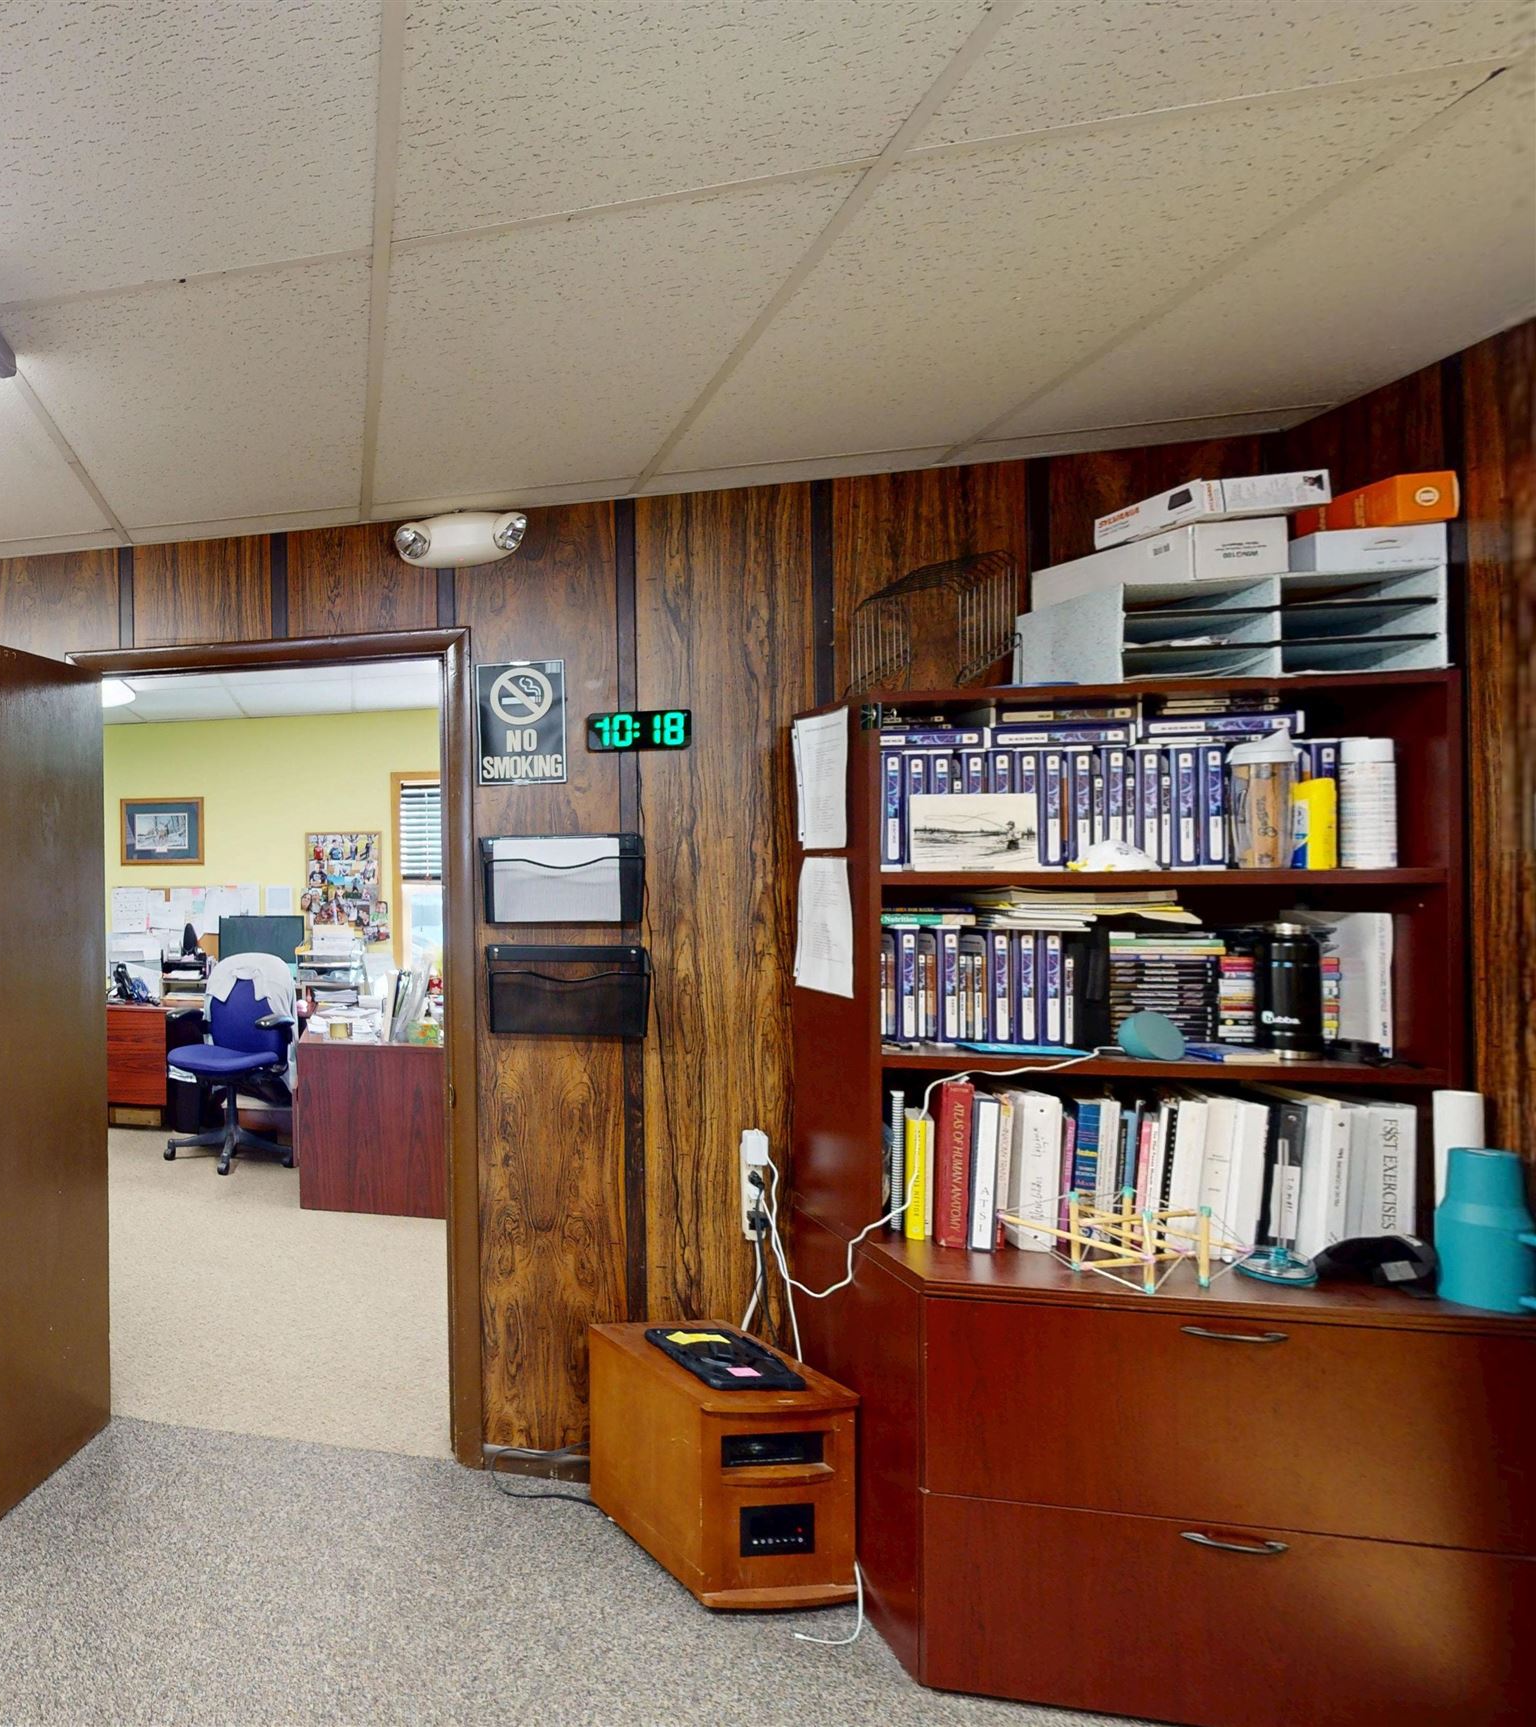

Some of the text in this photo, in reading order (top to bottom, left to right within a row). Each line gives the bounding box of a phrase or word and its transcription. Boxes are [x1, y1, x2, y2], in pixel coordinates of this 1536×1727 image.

[506, 728, 537, 753] NO
[594, 711, 685, 747] 10:18
[482, 753, 563, 779] SMOKING
[952, 1101, 964, 1129] ATLAS
[952, 1131, 963, 1143] OF
[951, 1145, 963, 1184] HUMAN
[949, 1184, 962, 1233] ANATOMY
[1380, 1154, 1399, 1231] EXERCISES
